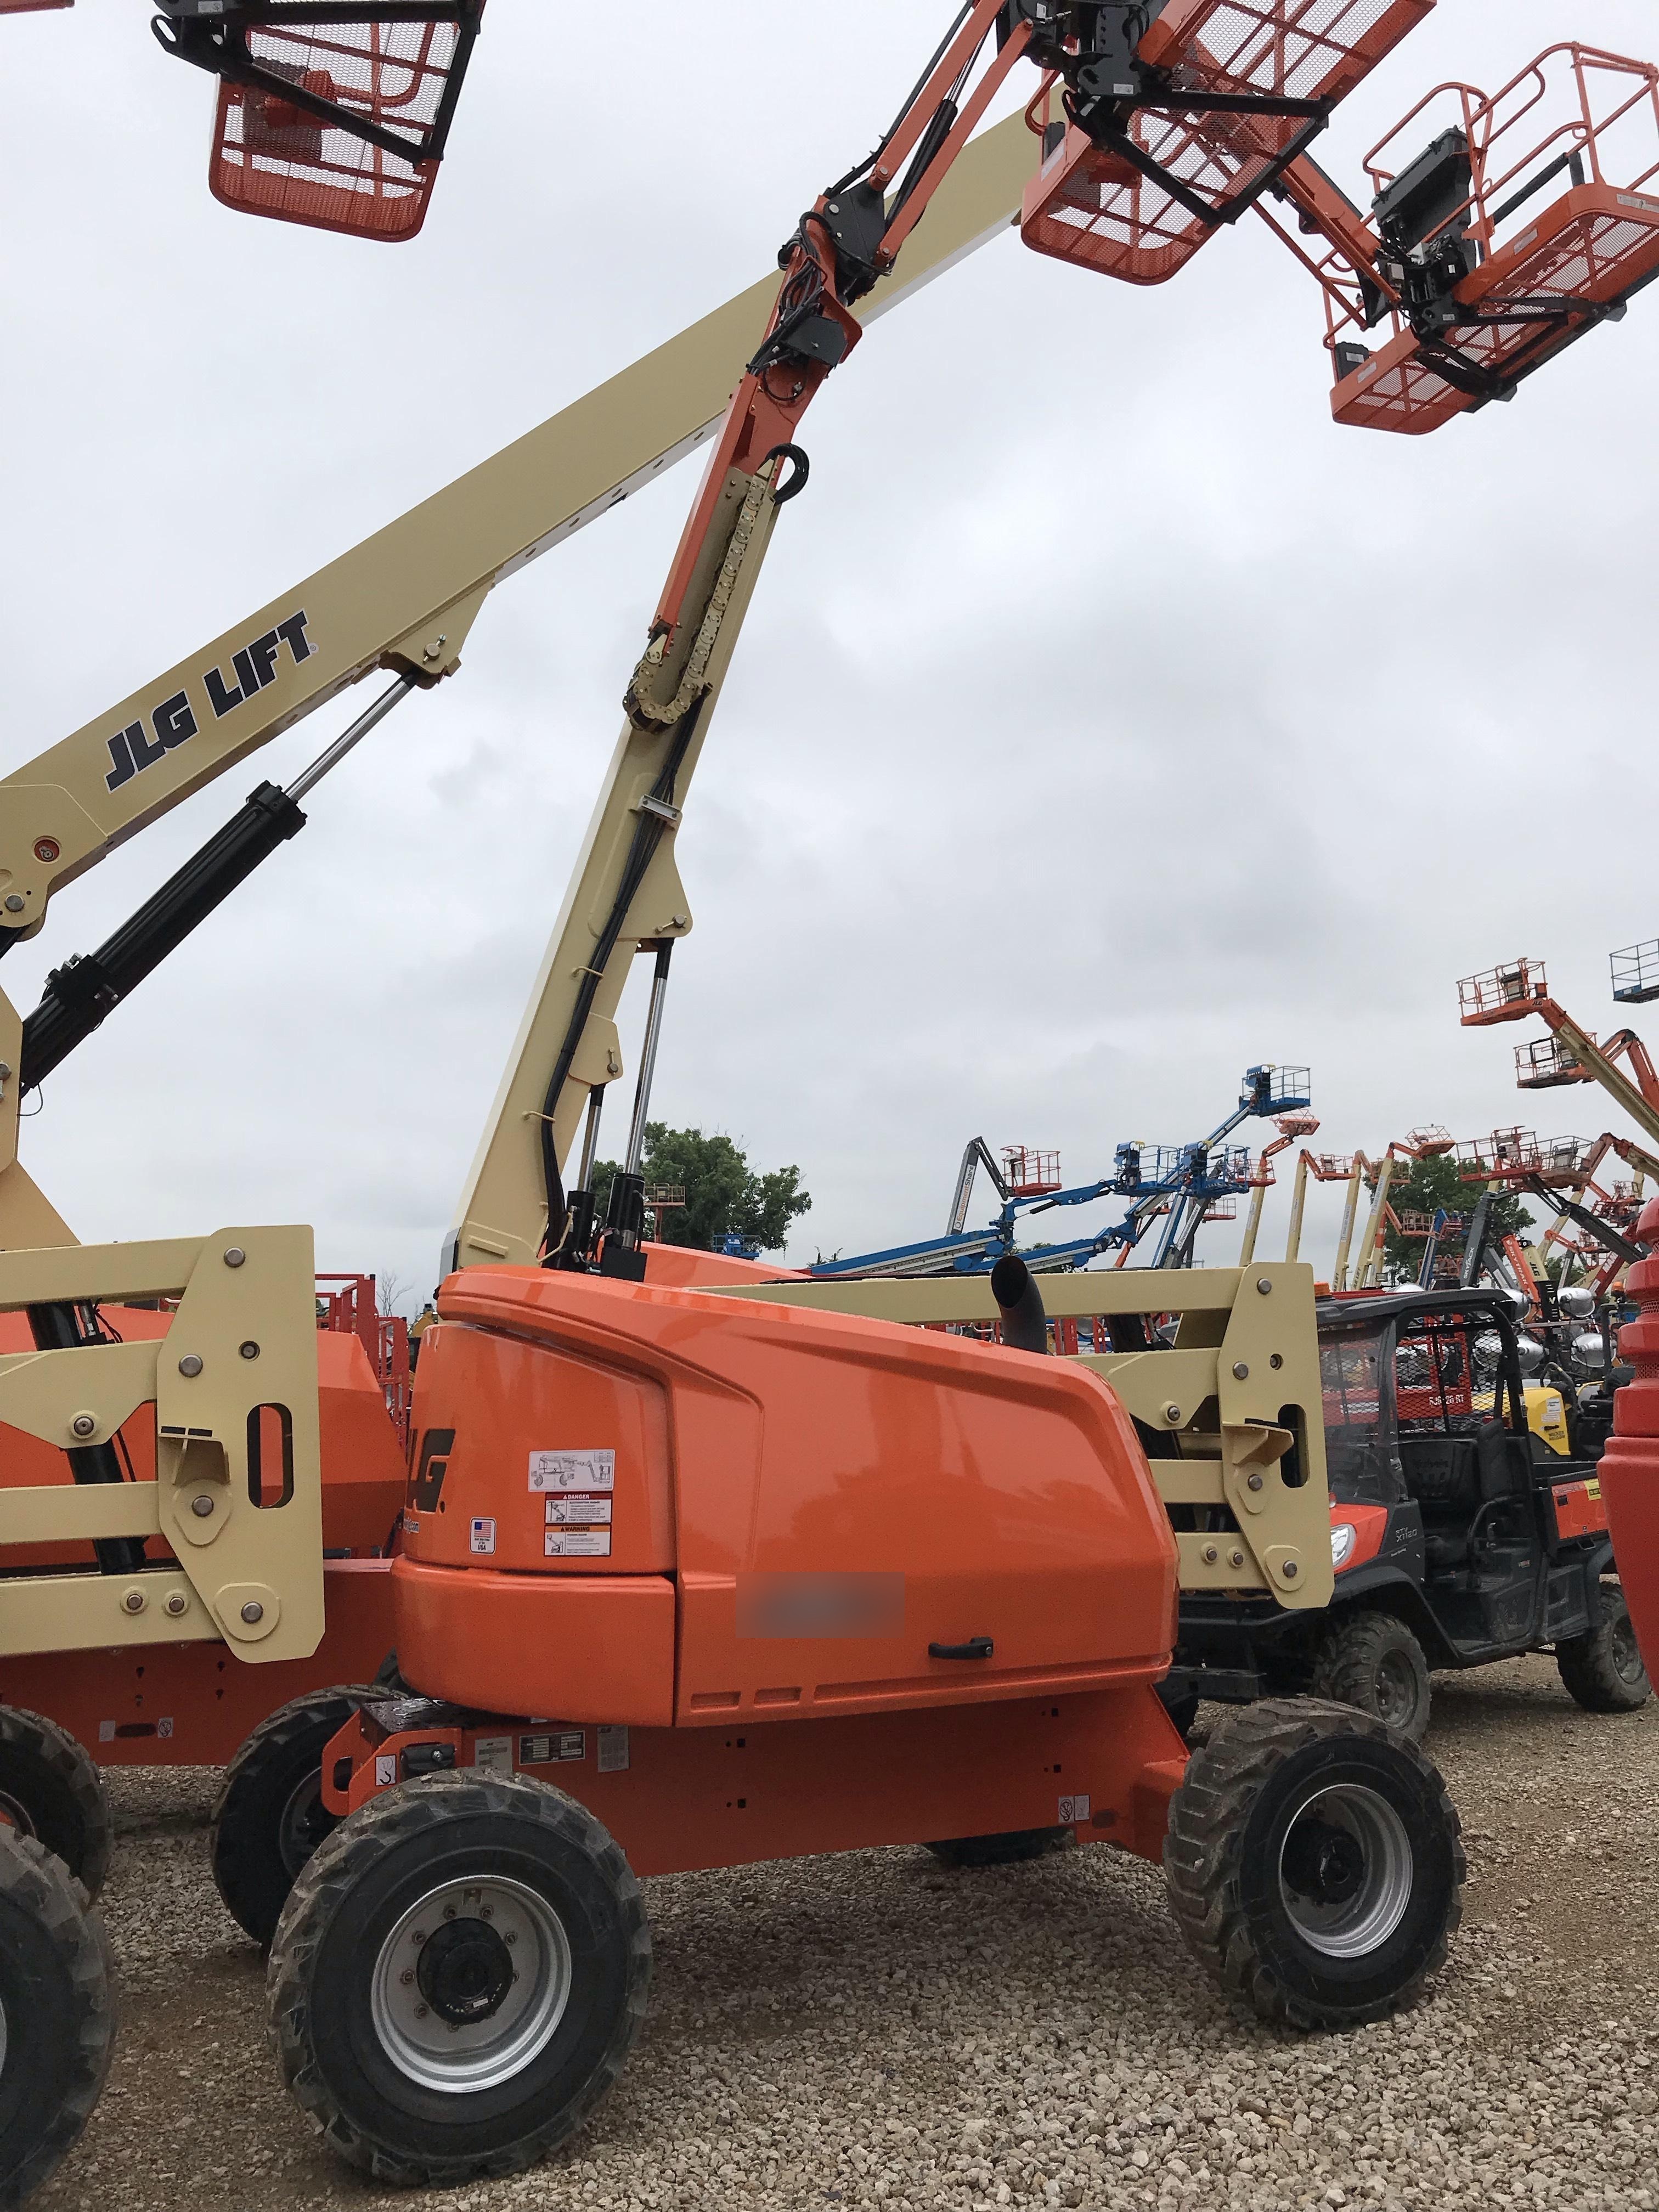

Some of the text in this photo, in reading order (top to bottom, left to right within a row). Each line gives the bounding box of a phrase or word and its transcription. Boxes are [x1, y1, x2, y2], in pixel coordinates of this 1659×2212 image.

[104, 609, 309, 793] JLG LIFT
[956, 1165, 975, 1222] EquipmentShare
[1530, 1262, 1540, 1277] JLG
